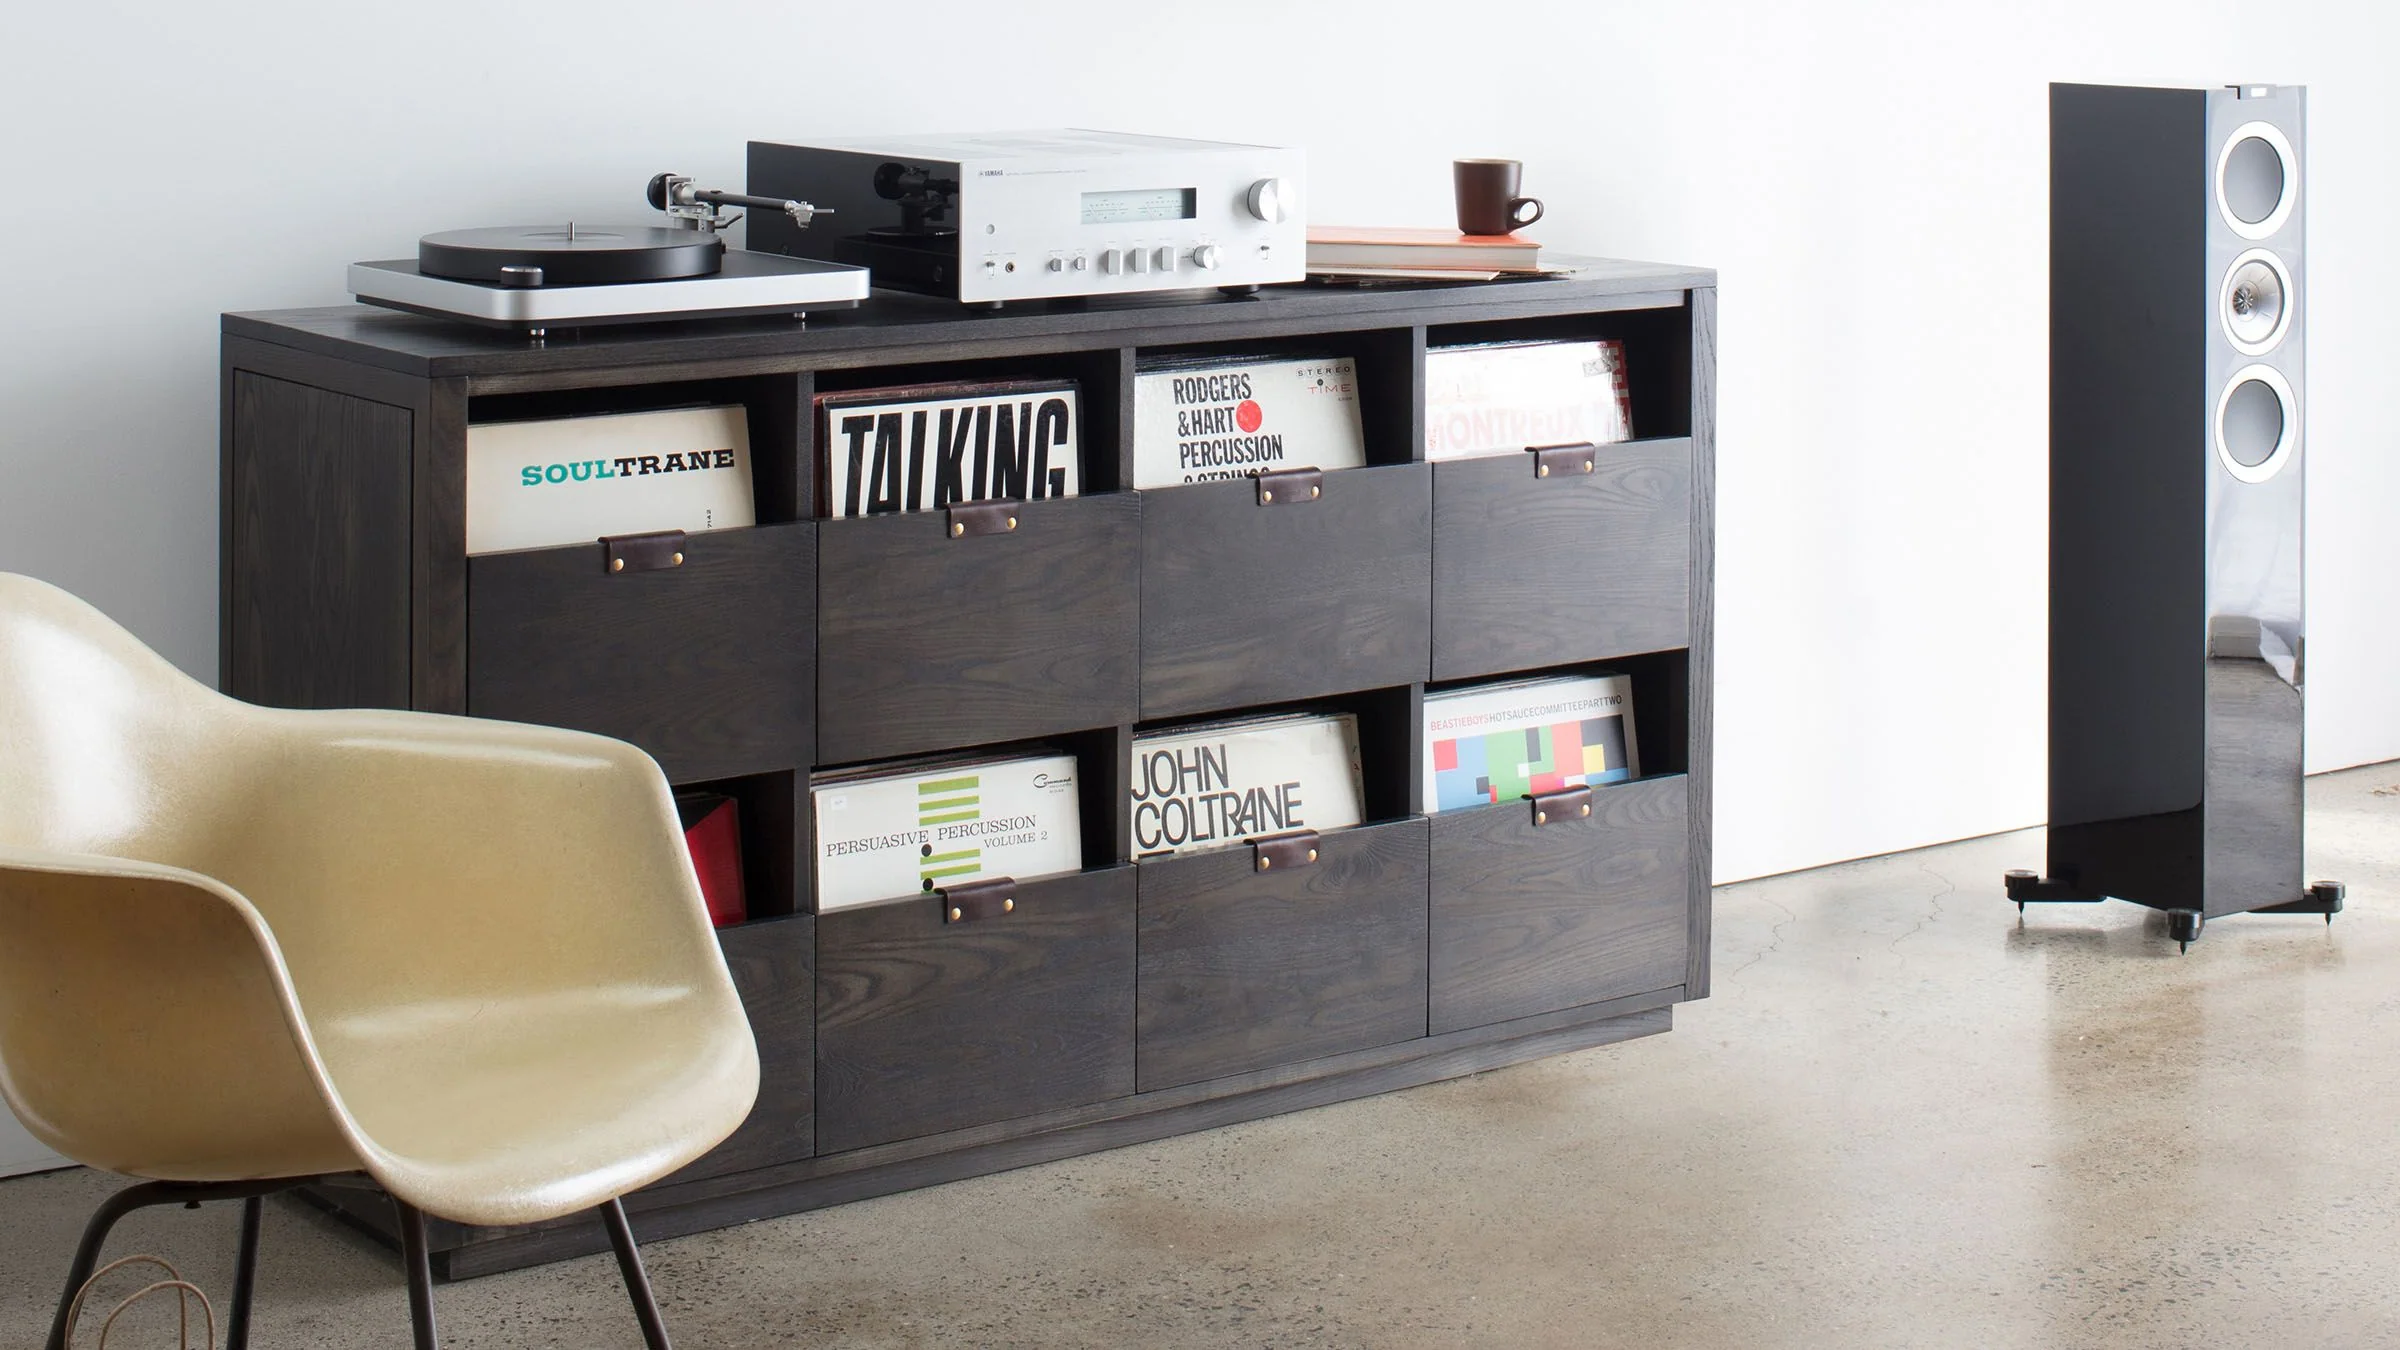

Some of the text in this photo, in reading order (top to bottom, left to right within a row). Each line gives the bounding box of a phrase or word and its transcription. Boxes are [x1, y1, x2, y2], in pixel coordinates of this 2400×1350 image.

[1173, 373, 1252, 405] RODGERS
[1297, 366, 1351, 377] STEREO
[1307, 379, 1352, 395] TIME
[521, 448, 735, 487] SOULTRANE
[1179, 434, 1284, 469] PERCUSSION
[1132, 743, 1229, 801] JOHN
[1134, 781, 1304, 850] COLTRANE
[826, 815, 1037, 857] PERSUASIVE PERCUSSION
[984, 831, 1048, 849] VOLUME 2
